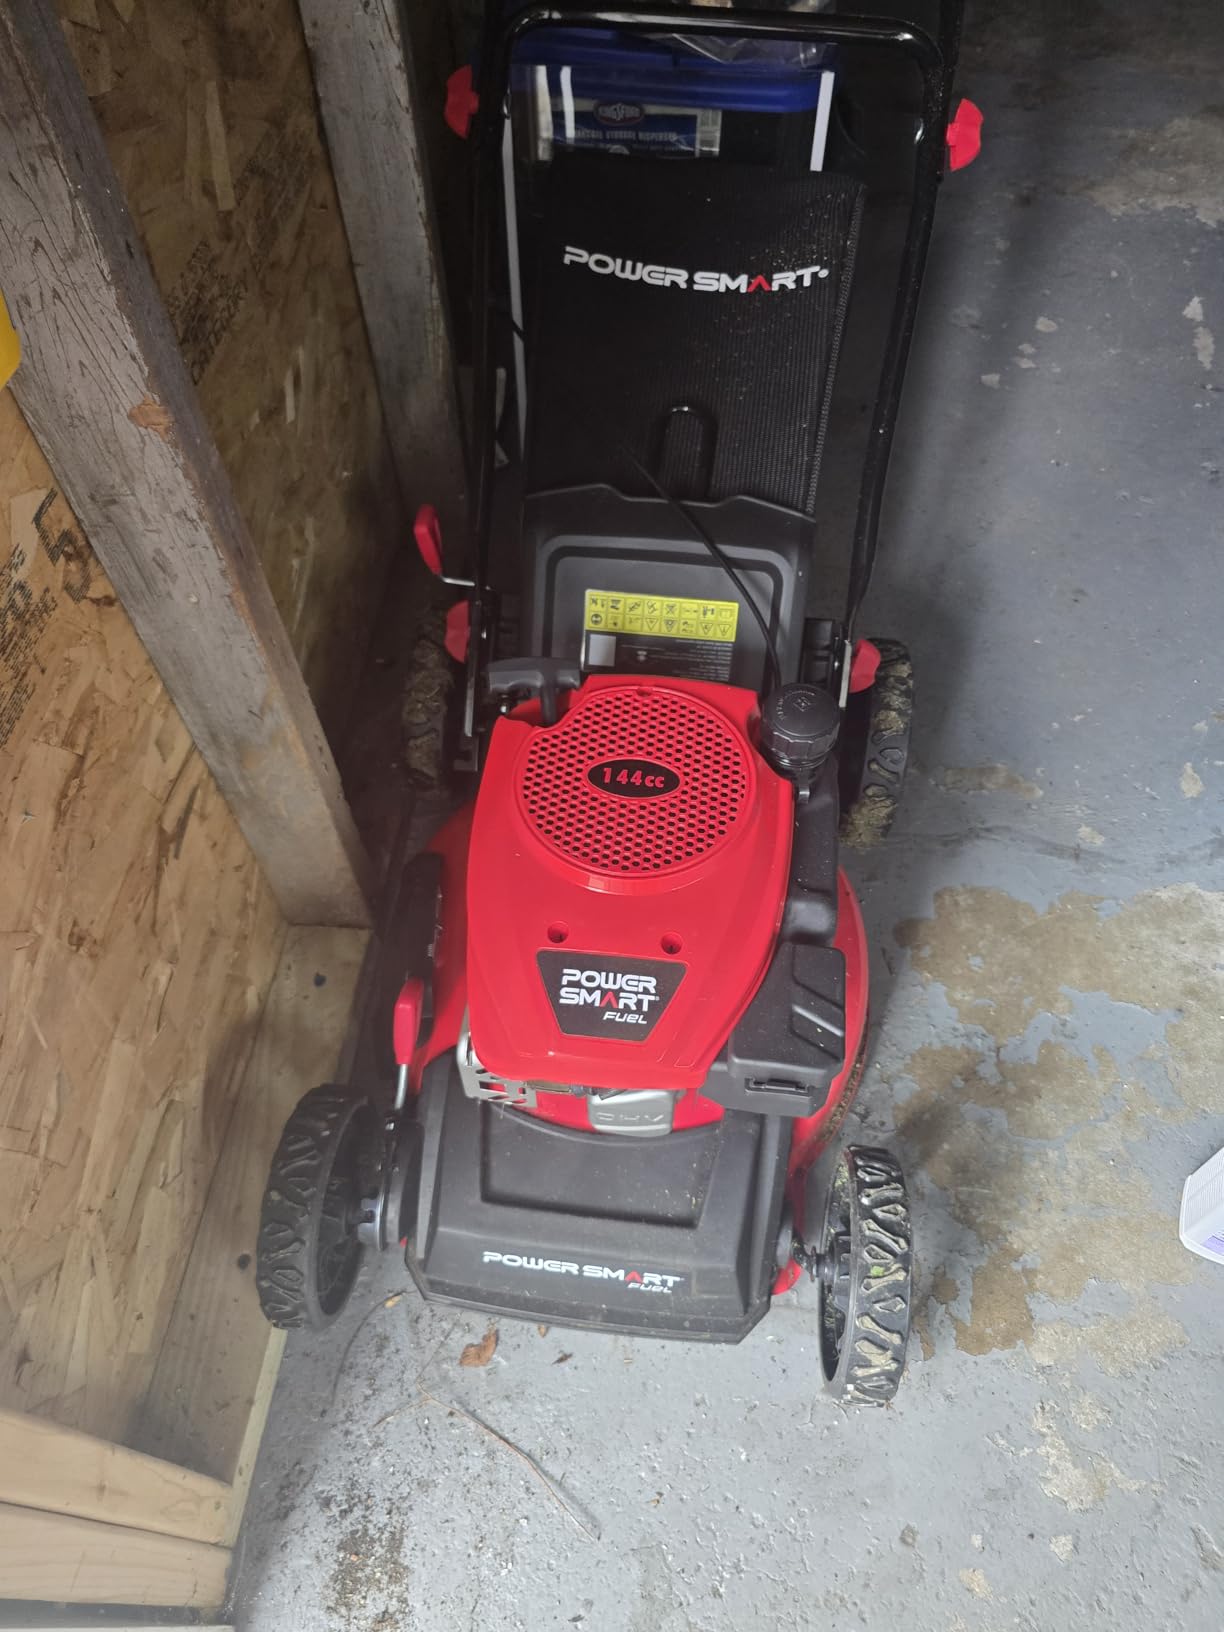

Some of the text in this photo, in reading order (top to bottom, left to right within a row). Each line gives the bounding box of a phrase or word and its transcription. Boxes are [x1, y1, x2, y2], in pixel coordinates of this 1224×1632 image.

[564, 245, 824, 294] POWER SMART
[603, 767, 665, 788] 144cc
[561, 968, 657, 994] POWER
[559, 987, 657, 1012] SMART
[603, 1011, 647, 1024] FUEL
[483, 1251, 681, 1288] POWER SMART
